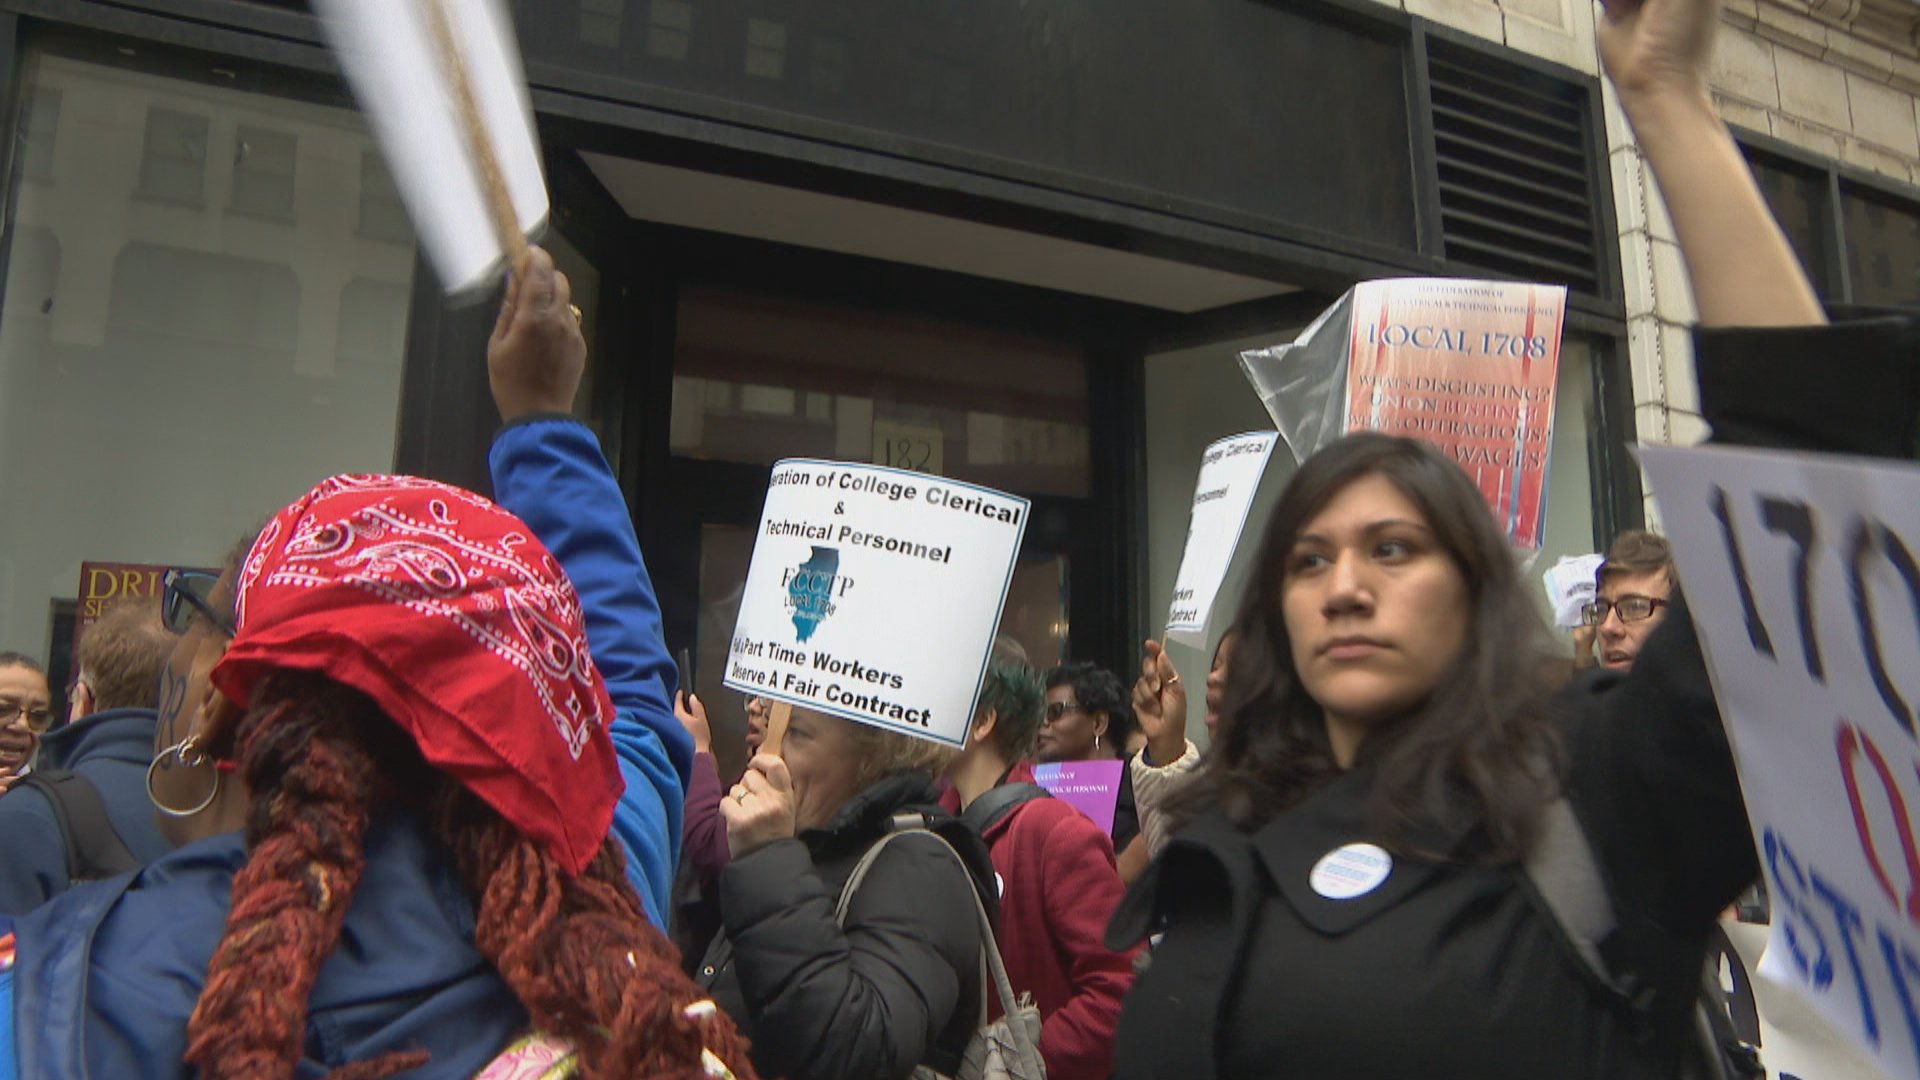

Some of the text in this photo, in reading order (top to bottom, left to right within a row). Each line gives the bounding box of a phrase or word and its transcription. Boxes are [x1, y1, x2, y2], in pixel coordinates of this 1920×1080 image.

[1369, 322, 1546, 359] LOCAL 1708
[1370, 391, 1438, 414] UNION
[885, 438, 931, 472] 182
[769, 469, 1021, 526] eration of College Clerical
[834, 501, 845, 516] &
[766, 519, 952, 564] Technical Personnel
[86, 569, 160, 600] DRI
[781, 566, 855, 598] FCCTP
[745, 637, 763, 657] Part
[769, 641, 807, 666] Time
[813, 651, 904, 690] Workers
[732, 661, 932, 728] Deserve A Fair Contract
